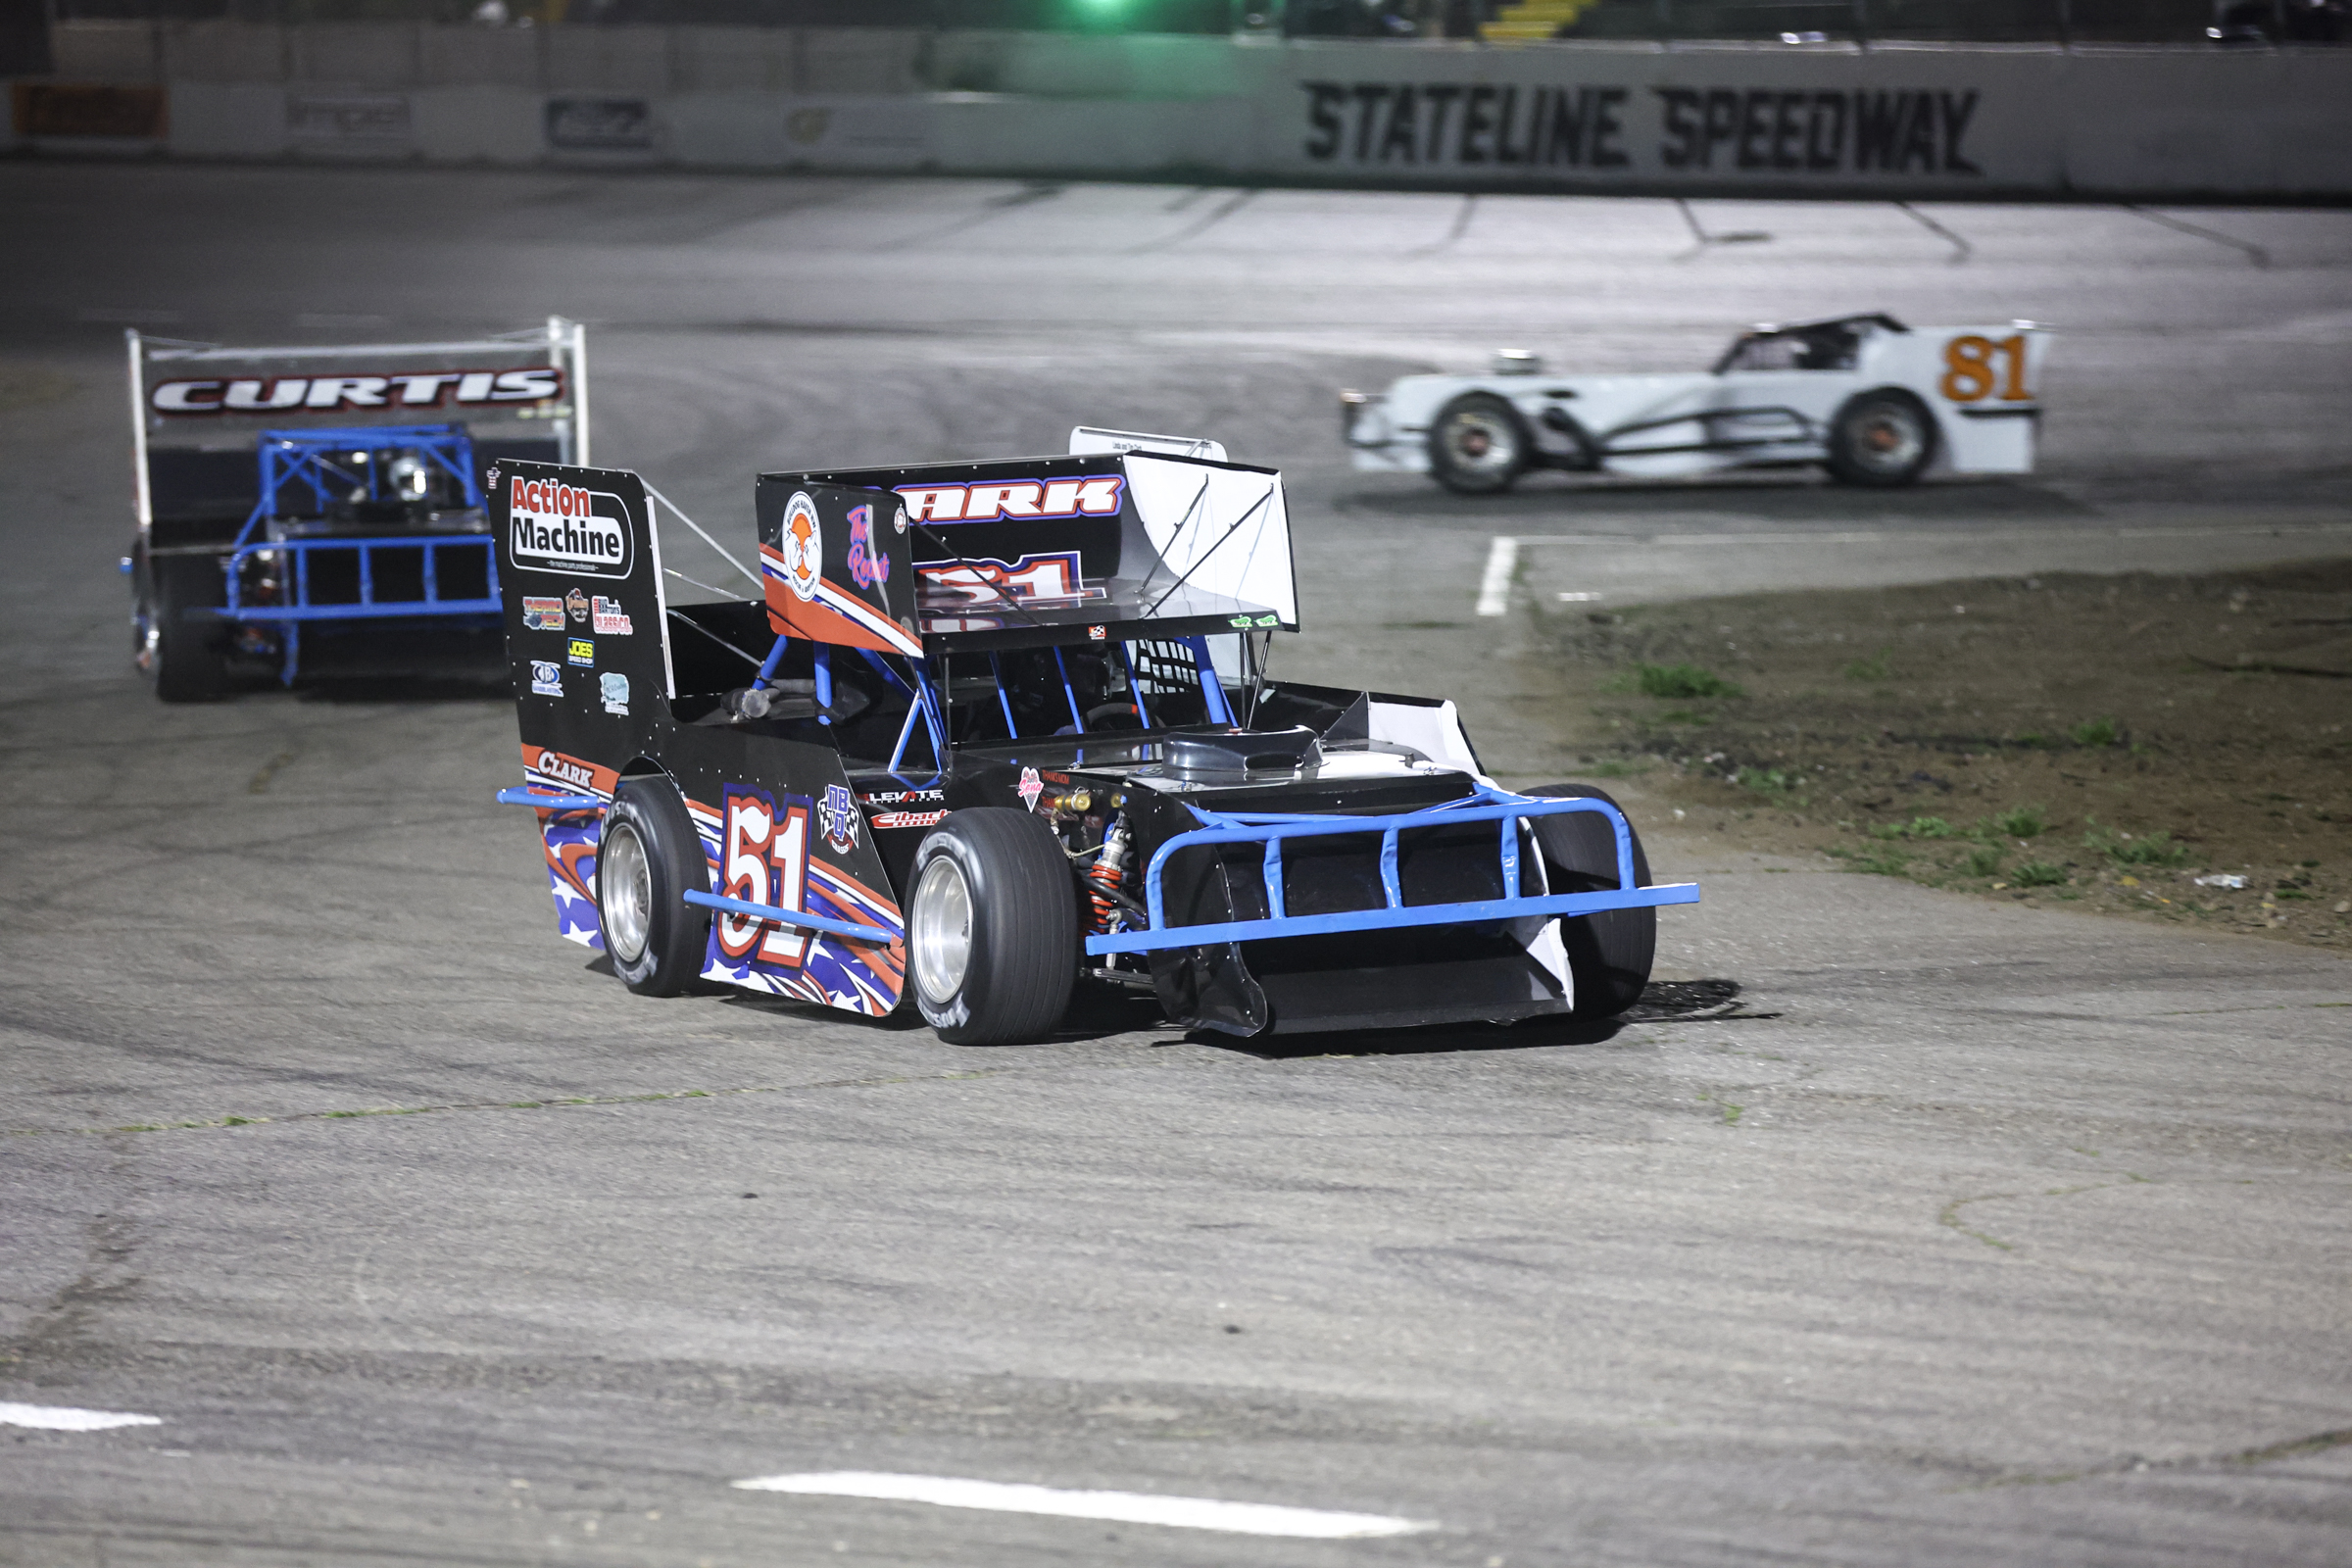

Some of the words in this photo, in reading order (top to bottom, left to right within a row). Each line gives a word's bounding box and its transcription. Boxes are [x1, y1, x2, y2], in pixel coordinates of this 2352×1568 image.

[1303, 80, 1631, 170] STATELINE
[1650, 84, 1984, 175] SPEEDWAY
[1939, 333, 2034, 403] 81
[153, 369, 561, 412] CURTIS
[513, 478, 590, 517] Action
[892, 476, 1124, 524] ARK
[513, 516, 619, 558] Machine
[848, 506, 868, 543] The
[918, 559, 1094, 605] 51
[524, 600, 562, 612] THERMO
[540, 614, 564, 627] TECH
[568, 641, 593, 658] JOES
[538, 751, 593, 788] CLARK
[856, 789, 943, 803] ELEVATE
[717, 796, 808, 968] 51
